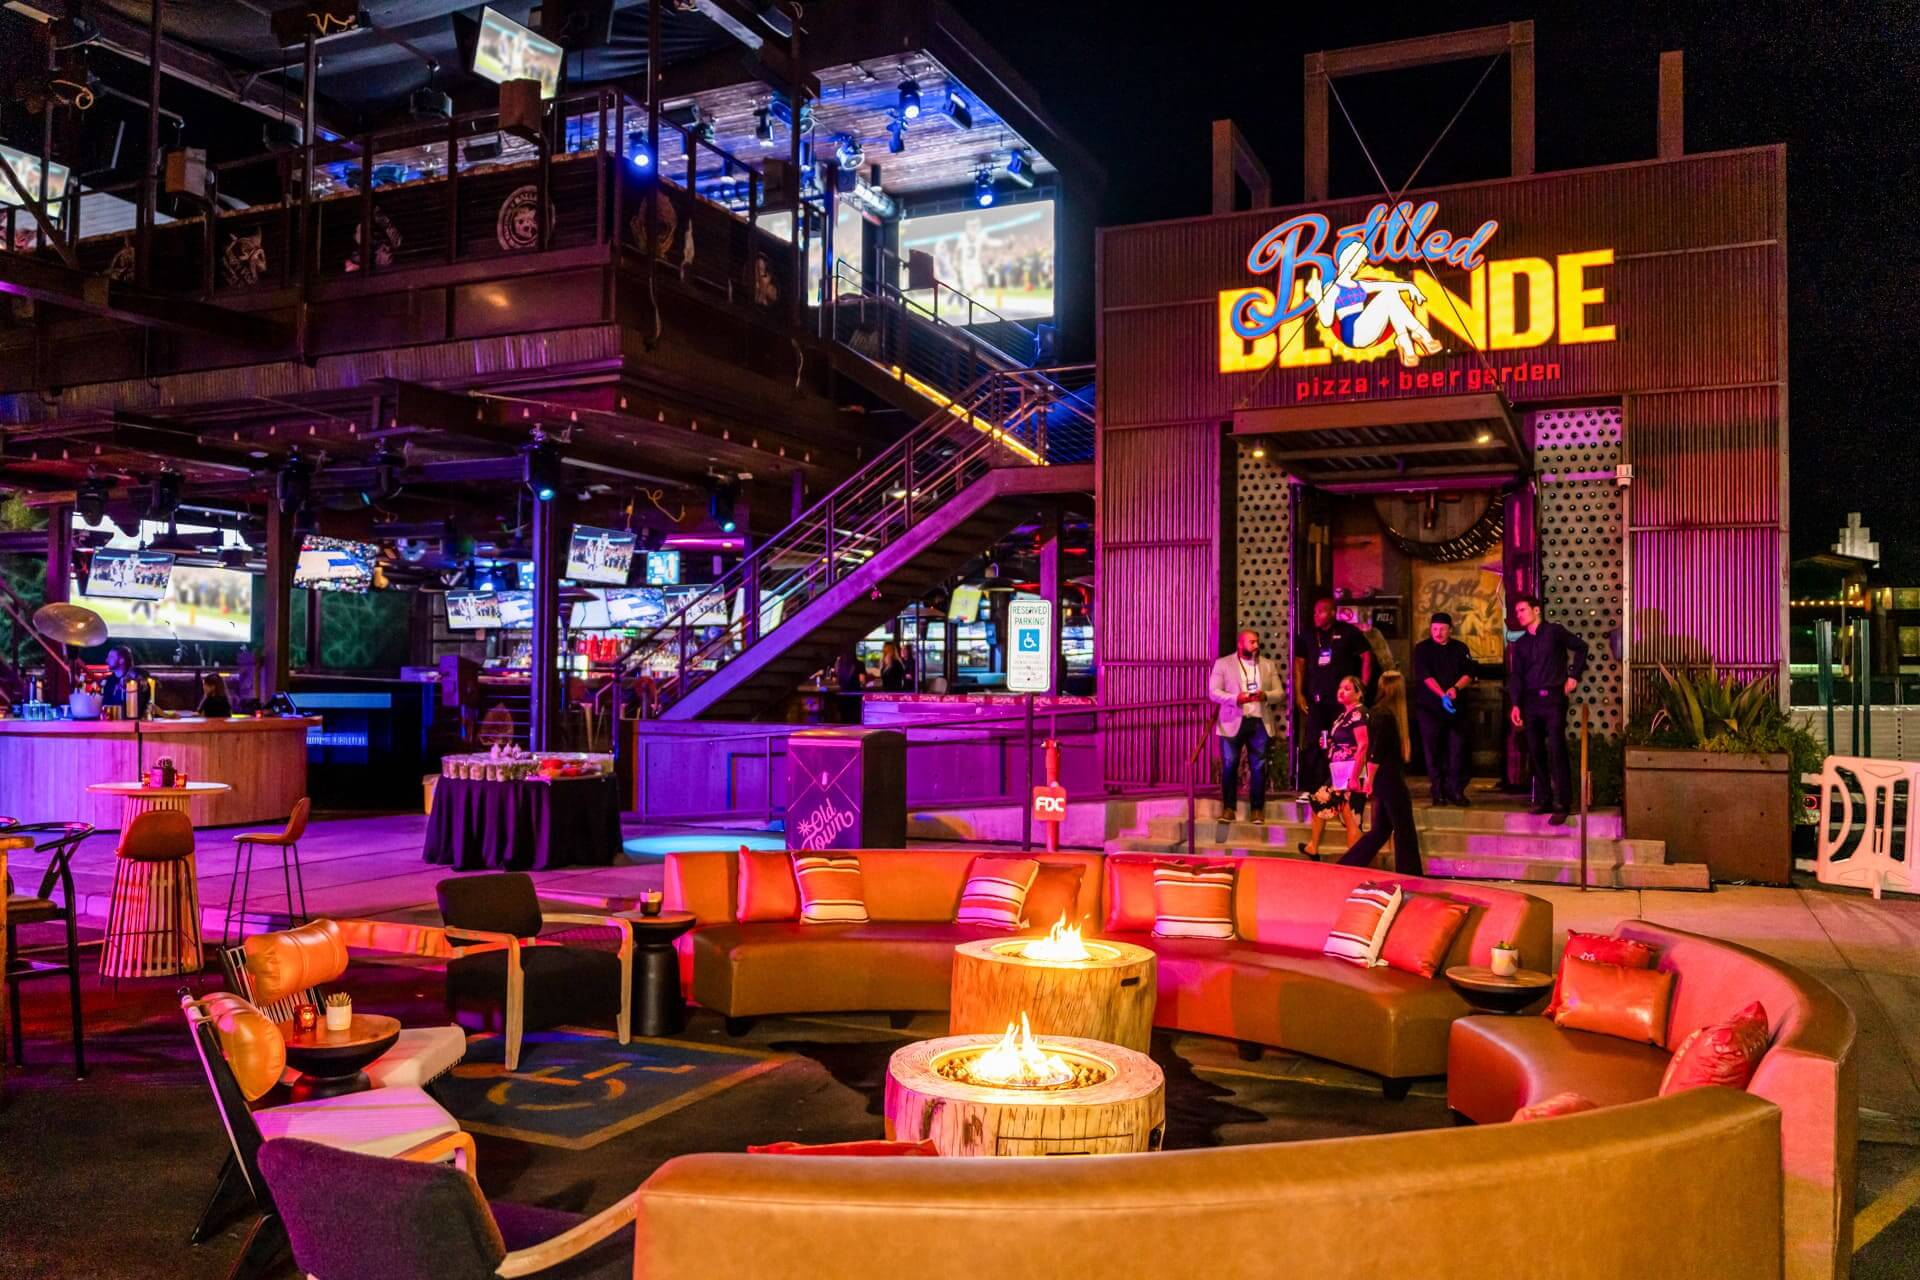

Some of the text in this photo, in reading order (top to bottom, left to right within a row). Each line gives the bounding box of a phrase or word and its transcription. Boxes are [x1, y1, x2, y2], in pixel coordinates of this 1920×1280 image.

[1218, 248, 1617, 374] BLONDE
[1296, 377, 1369, 401] pizza
[1399, 367, 1462, 391] beer
[1467, 362, 1561, 391] garden
[1012, 606, 1048, 615] RESERVED
[1014, 617, 1045, 625] PARKING
[809, 797, 837, 833] Old
[1035, 796, 1065, 812] FDC
[801, 811, 854, 850] Town
